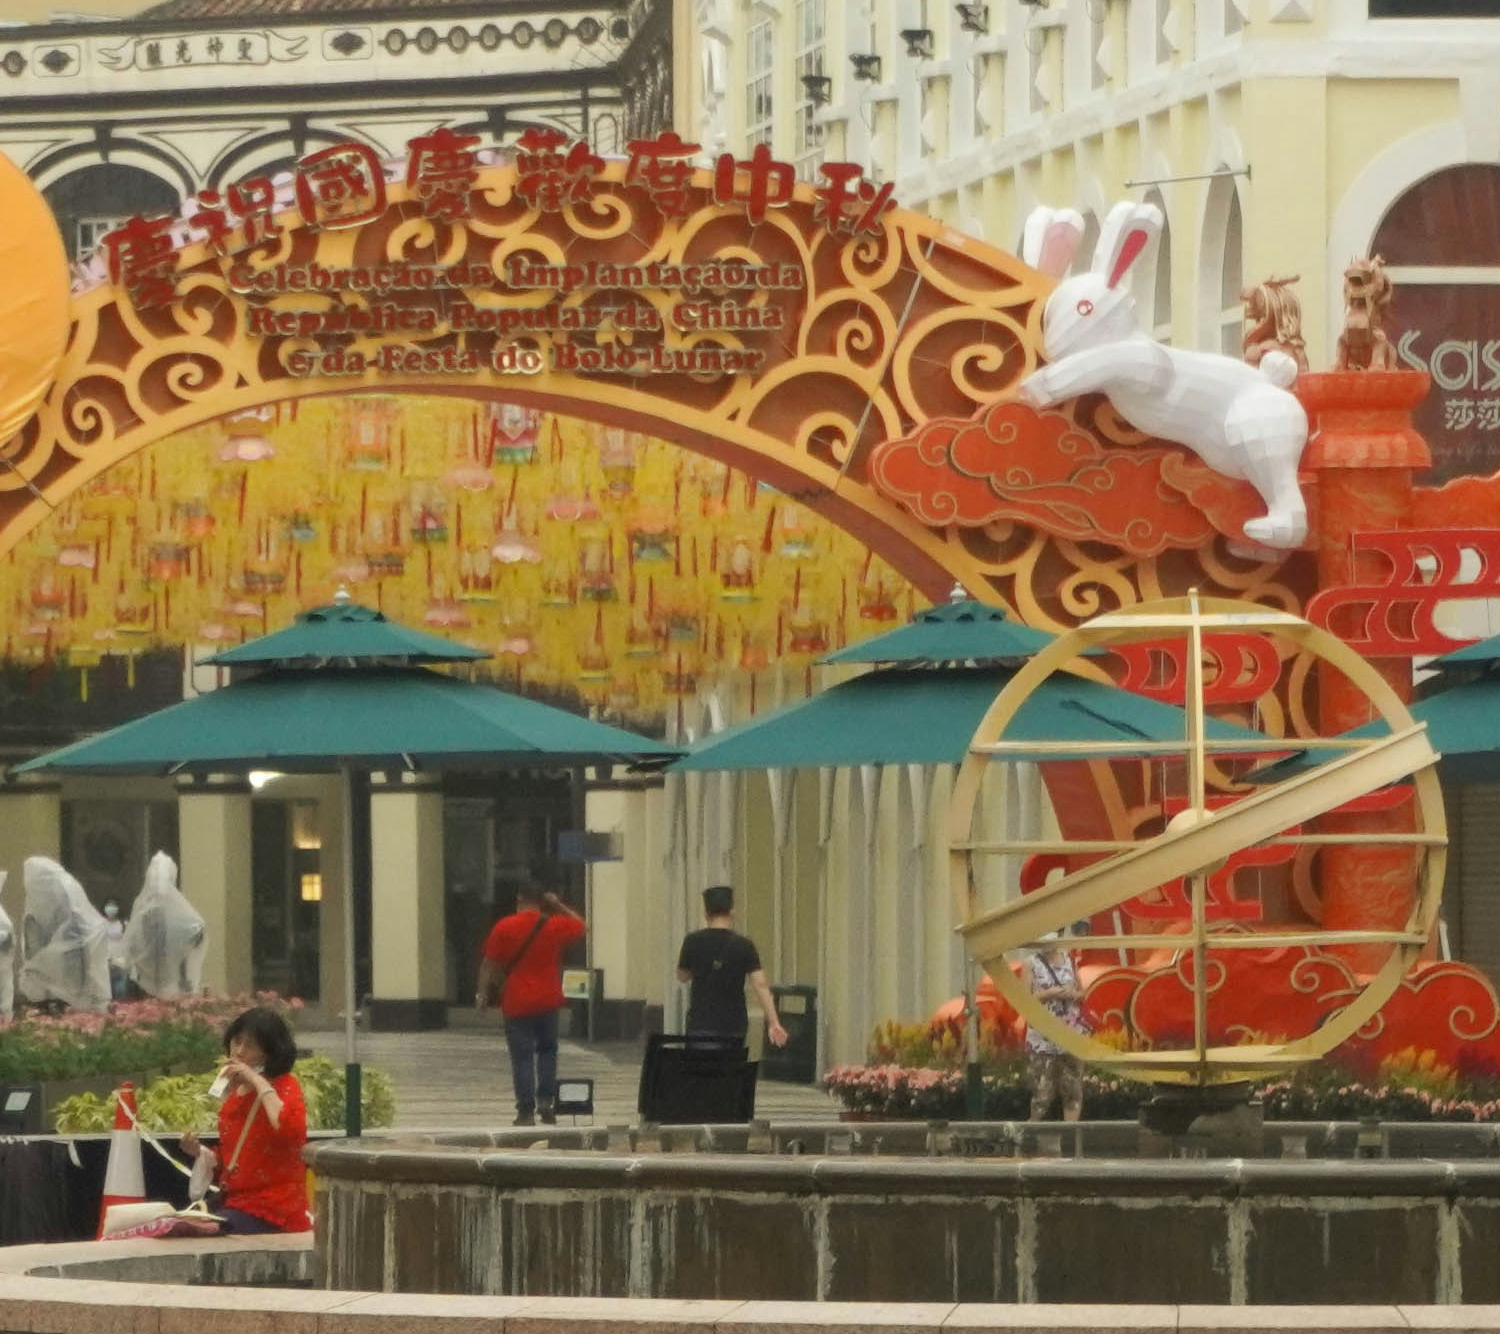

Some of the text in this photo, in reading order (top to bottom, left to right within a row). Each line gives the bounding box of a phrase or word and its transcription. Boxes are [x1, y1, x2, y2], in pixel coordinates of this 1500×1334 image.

[229, 258, 804, 295] Celebração da Implantação da
[247, 301, 785, 338] República Popular da China
[320, 346, 366, 375] da
[378, 344, 480, 374] Festa
[494, 343, 544, 375] do
[552, 342, 640, 374] Bolo
[650, 343, 766, 374] Lunar
